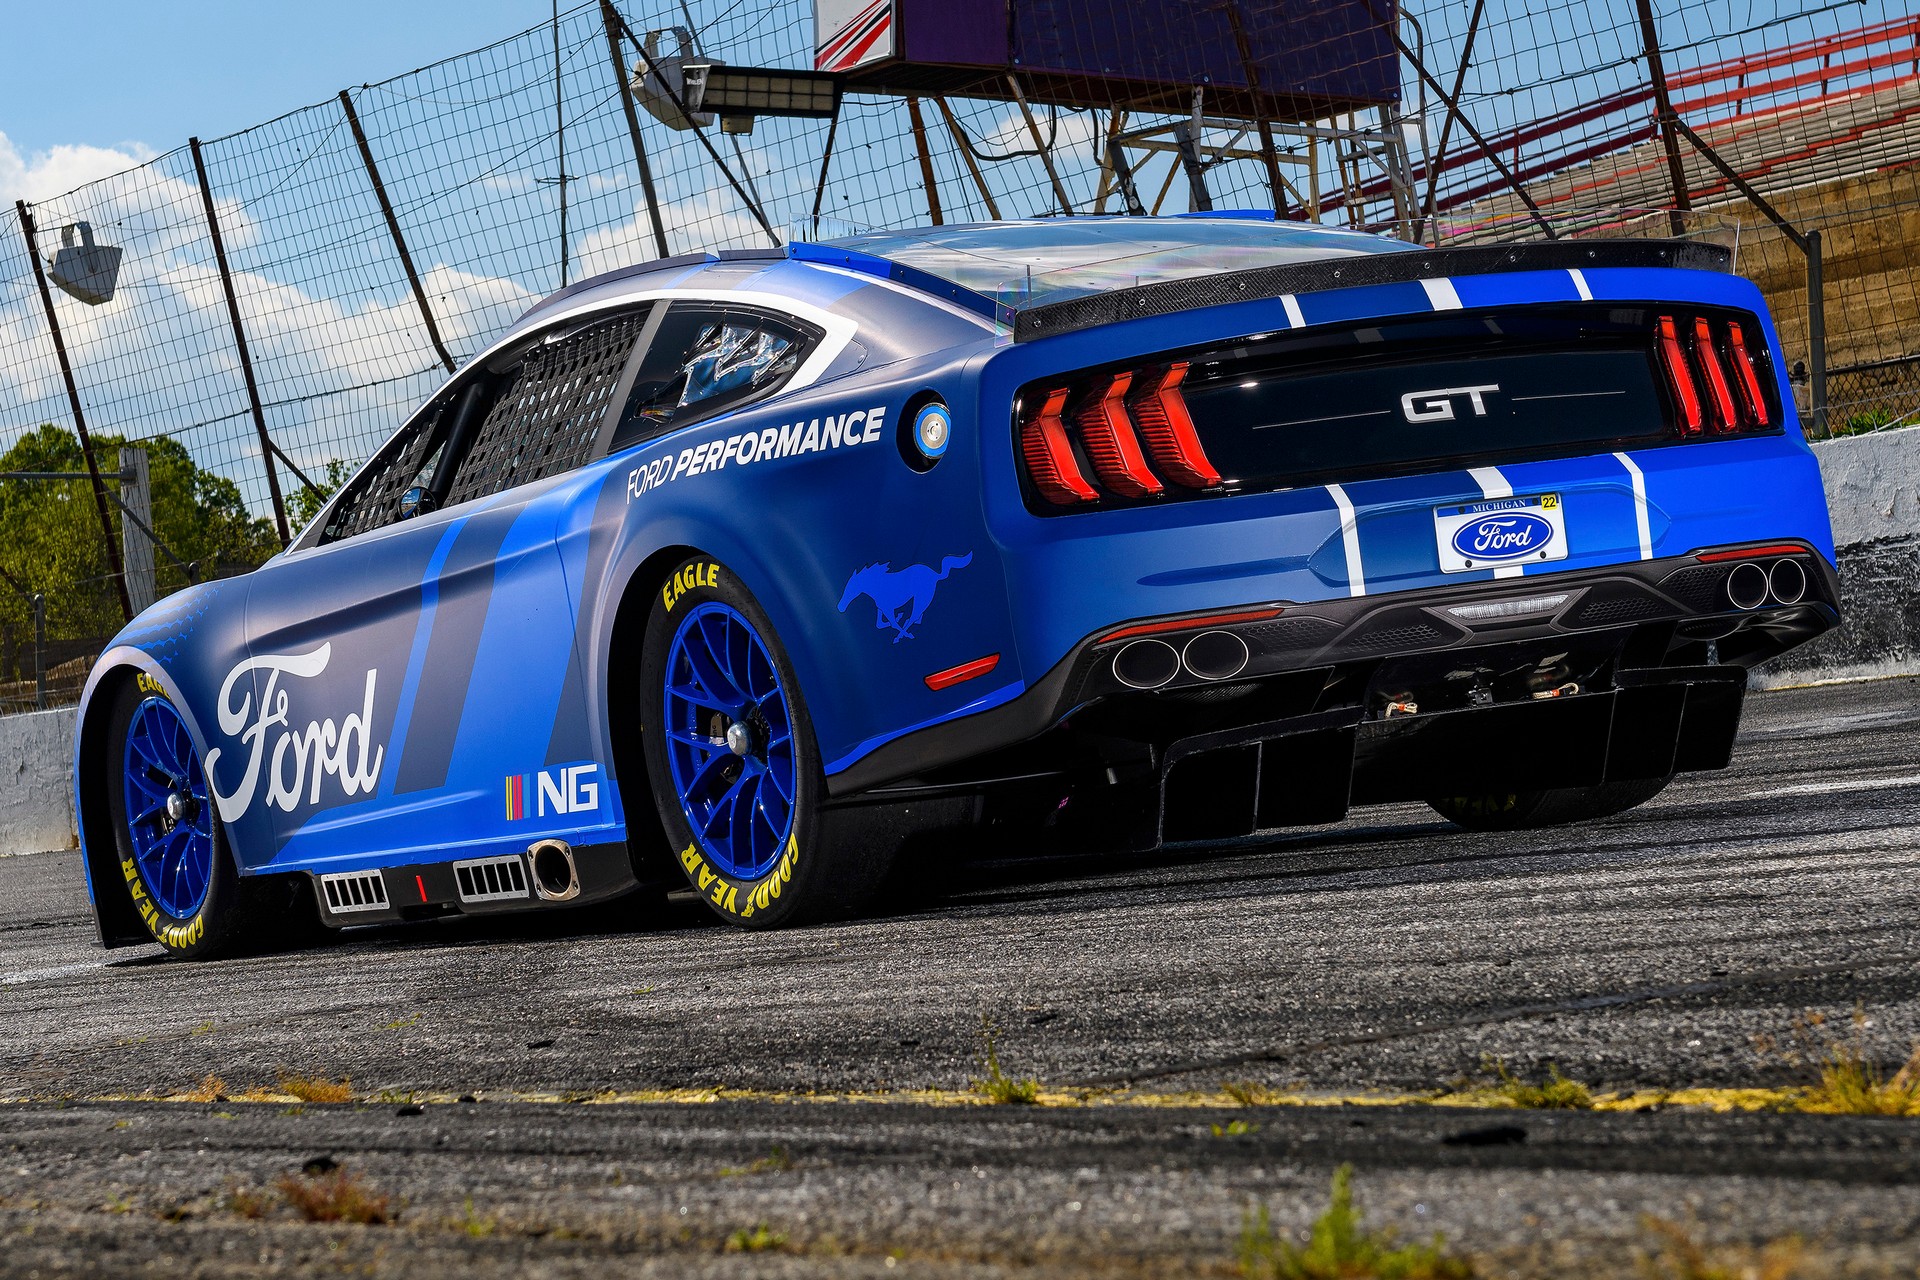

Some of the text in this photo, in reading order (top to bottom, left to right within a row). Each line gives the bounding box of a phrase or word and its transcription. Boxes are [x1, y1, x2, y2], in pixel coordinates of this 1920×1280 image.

[1400, 383, 1500, 424] GT
[626, 405, 887, 505] FORD PERFORMANCE
[1472, 499, 1526, 513] MICHIGAN
[1542, 496, 1556, 509] 22
[1474, 520, 1533, 551] Ford
[663, 562, 720, 613] EAGLE
[204, 641, 383, 823] Ford
[537, 763, 600, 818] NG
